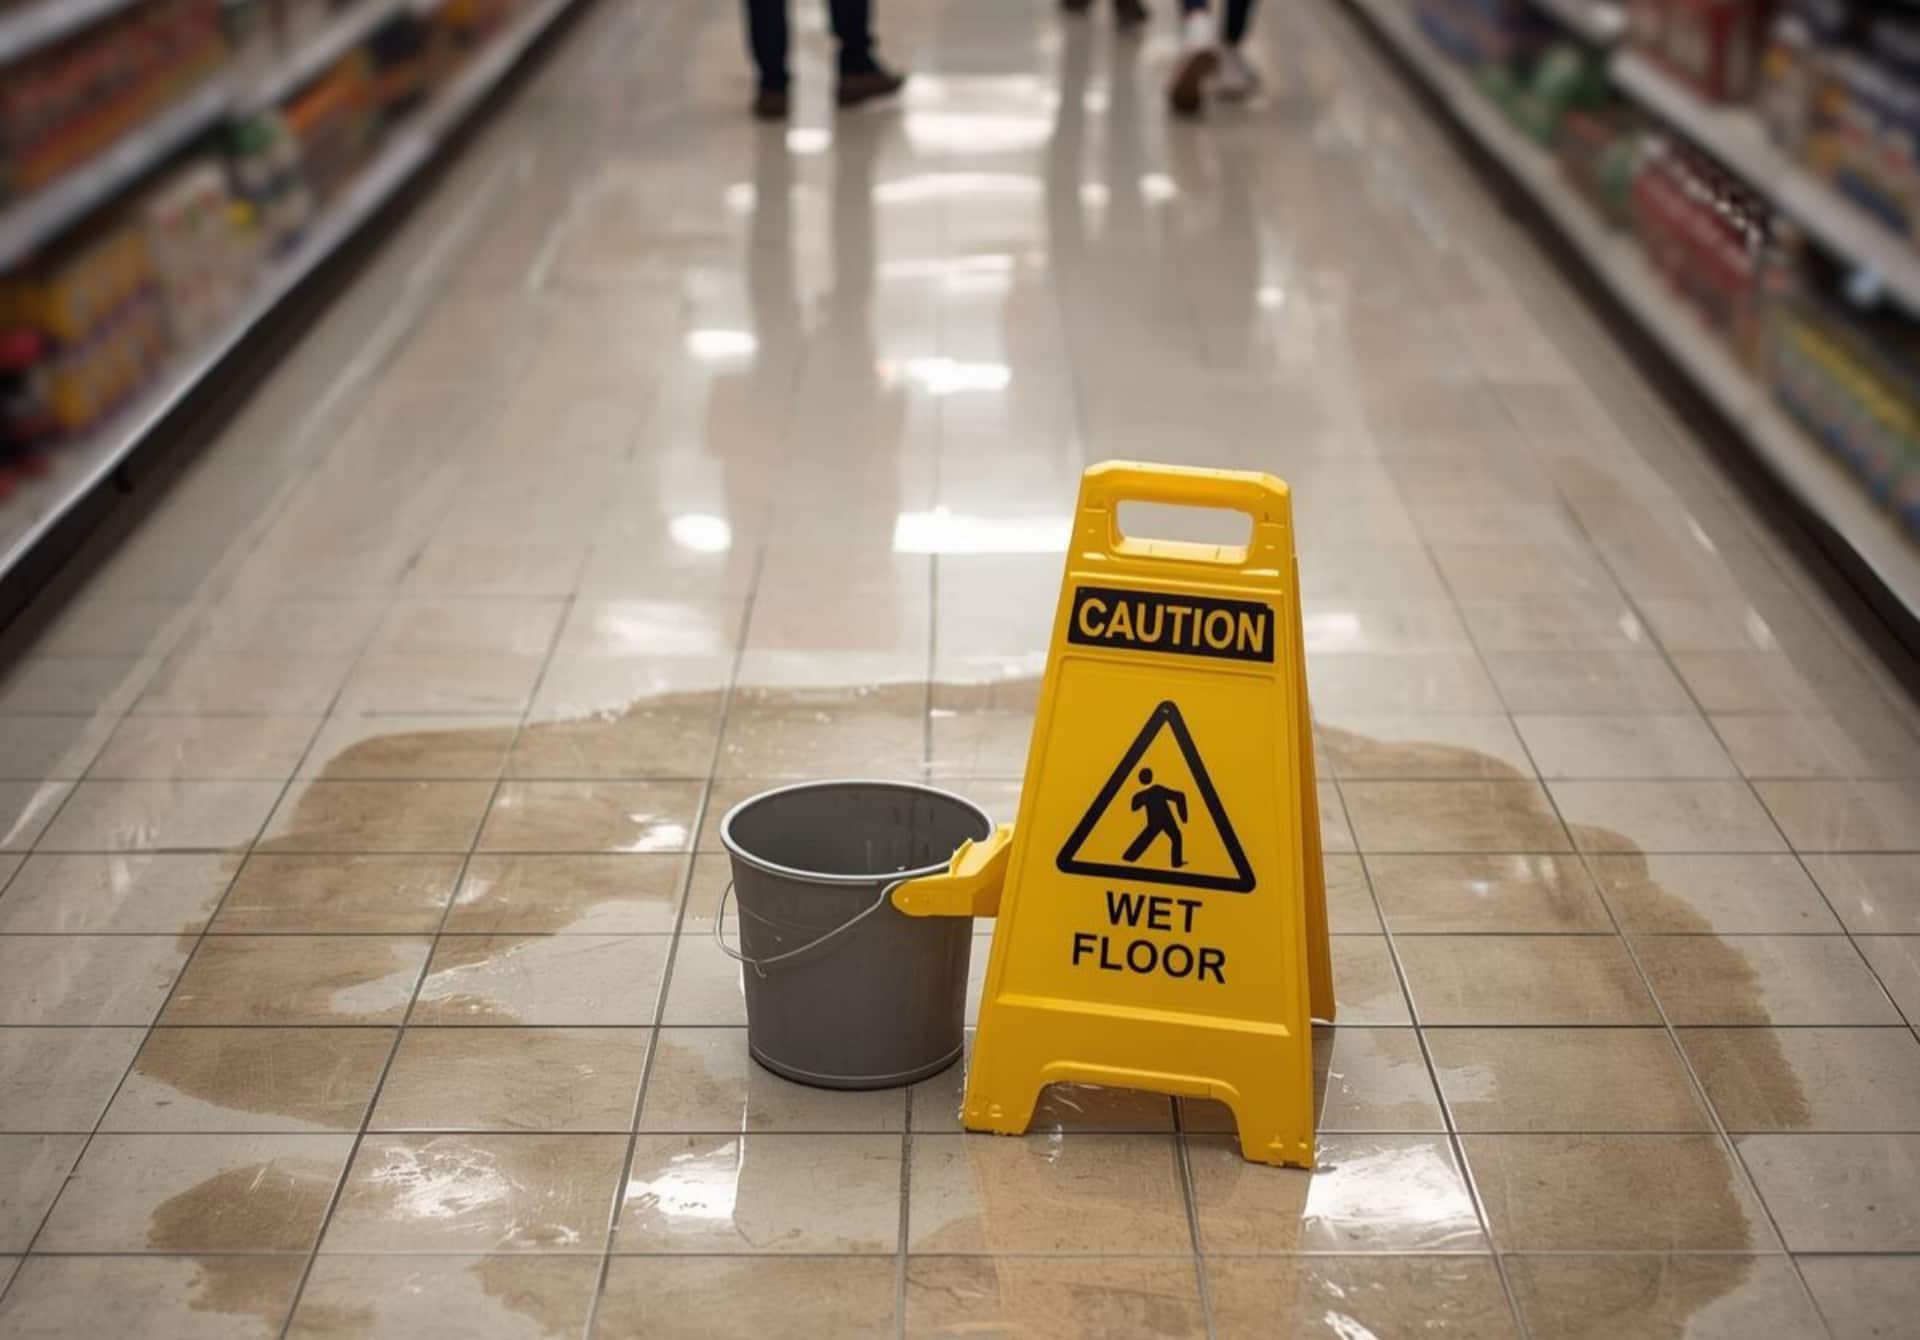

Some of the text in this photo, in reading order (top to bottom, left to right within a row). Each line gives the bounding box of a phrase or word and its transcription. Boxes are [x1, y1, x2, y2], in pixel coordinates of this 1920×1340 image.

[1078, 597, 1266, 653] CAUTION
[1106, 890, 1203, 933] WET
[1072, 932, 1226, 984] FLOOR
